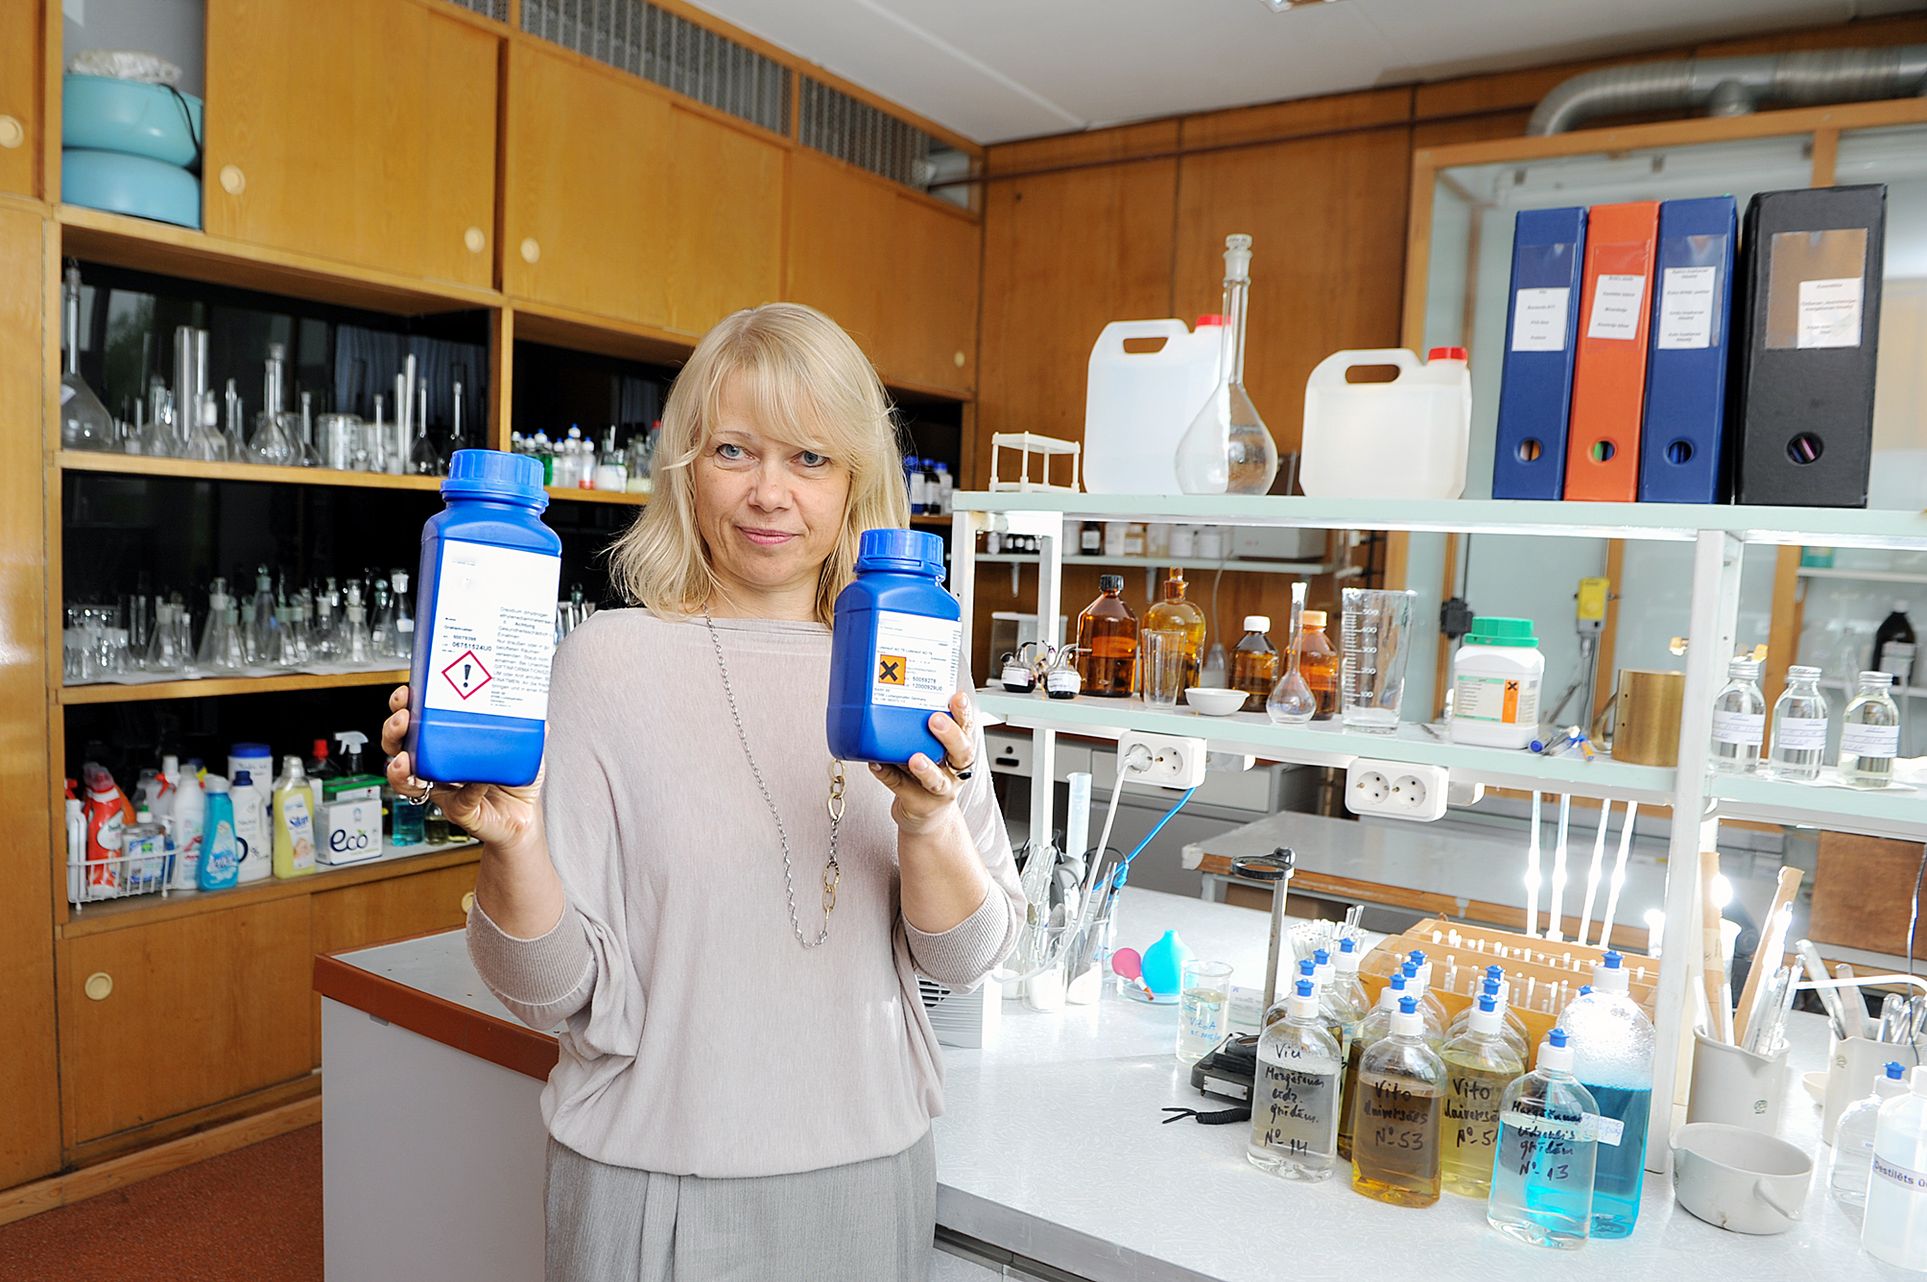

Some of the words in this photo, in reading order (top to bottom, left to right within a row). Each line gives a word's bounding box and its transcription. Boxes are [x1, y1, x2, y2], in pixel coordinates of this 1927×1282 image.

[330, 829, 368, 852] eco
[1375, 1080, 1412, 1102] Vito
[1453, 1078, 1490, 1100] Vito
